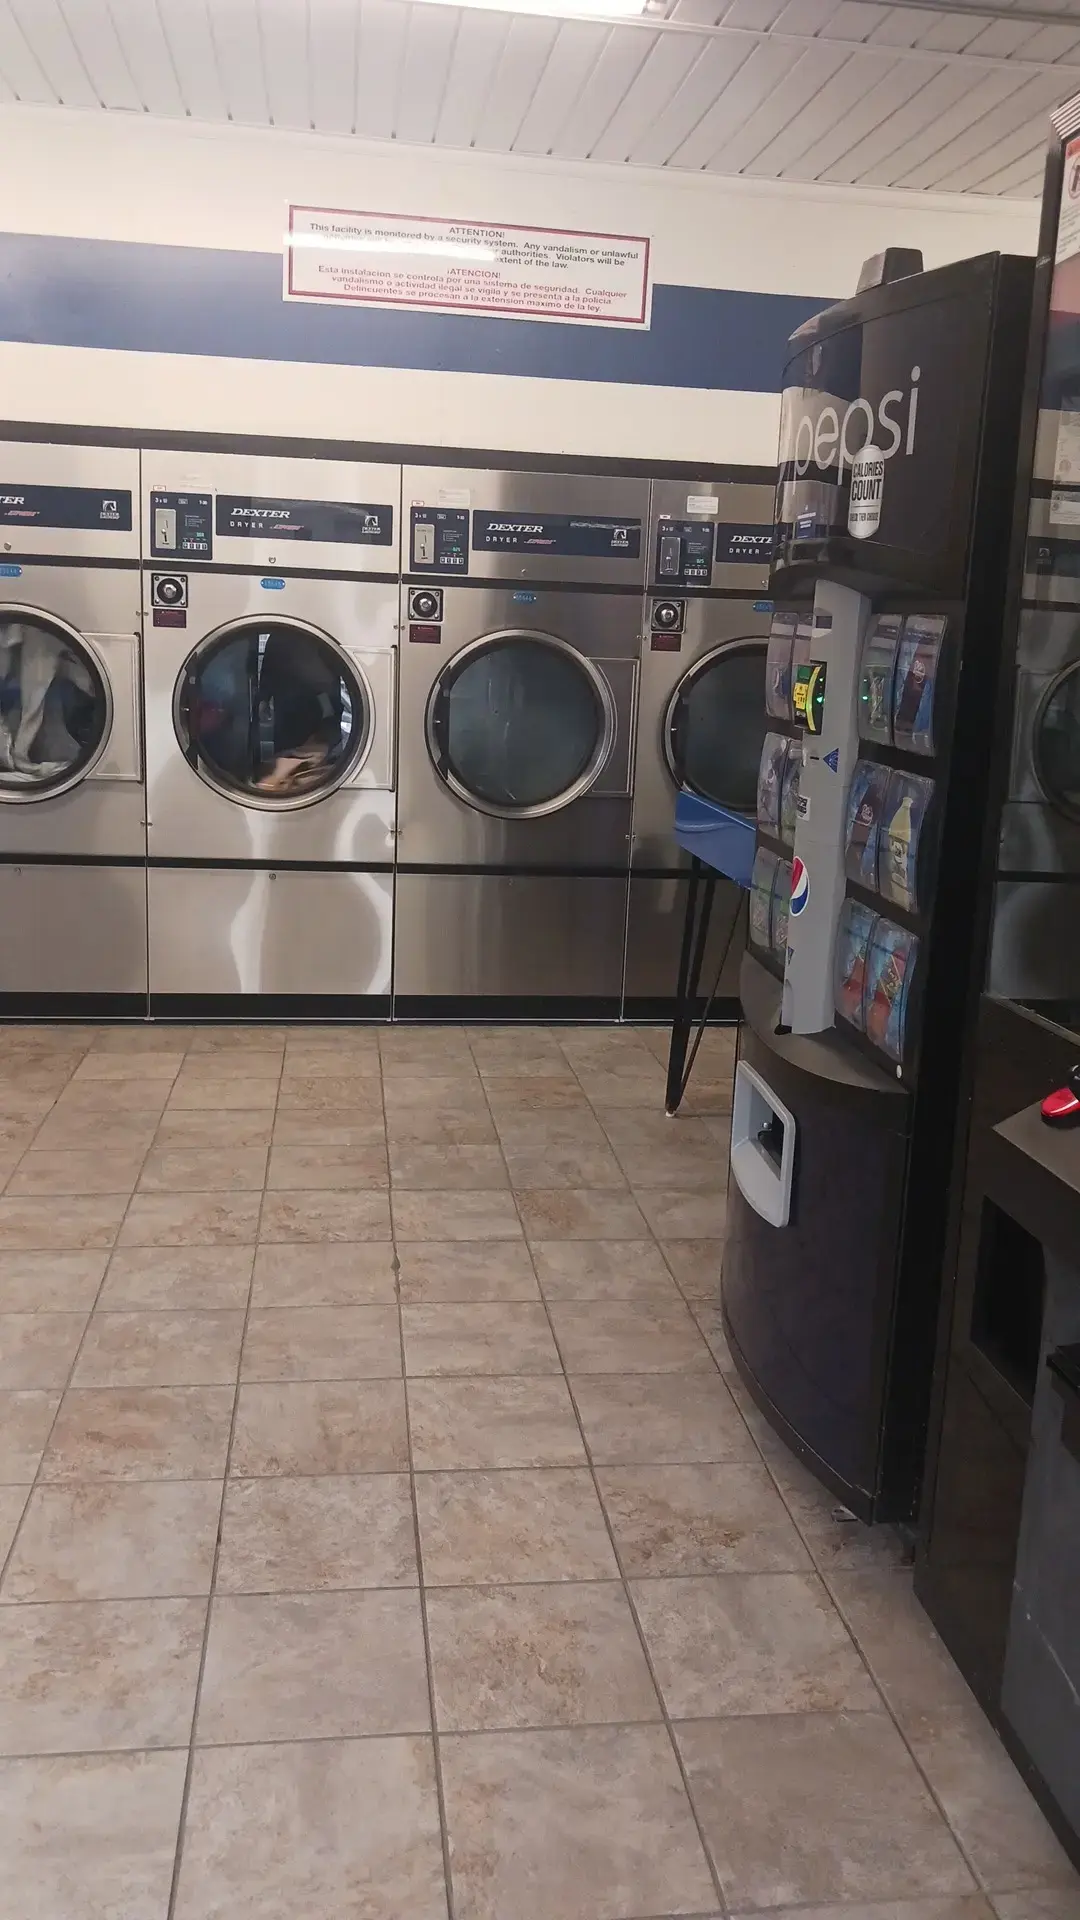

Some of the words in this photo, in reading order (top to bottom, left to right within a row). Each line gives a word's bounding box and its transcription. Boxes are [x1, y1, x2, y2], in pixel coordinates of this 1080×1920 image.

[449, 227, 505, 238] ATTENTION!
[310, 223, 329, 232] This
[331, 225, 362, 235] facility
[375, 229, 422, 239] monitored
[424, 233, 435, 241] by
[446, 236, 482, 246] security
[484, 239, 518, 248] system.
[524, 242, 540, 251] Any
[543, 245, 588, 254] vandalism
[601, 249, 639, 259] unlawful
[501, 249, 551, 259] authorities.
[556, 253, 595, 263] Violators
[597, 257, 612, 265] will
[524, 258, 533, 266] of
[535, 259, 550, 267] the
[552, 261, 569, 269] law.
[318, 265, 339, 273] Esta
[341, 267, 391, 278] instalacion
[406, 273, 444, 282] controla
[446, 276, 462, 284] por
[483, 279, 518, 289] sistema
[534, 284, 580, 294] seguridad.
[585, 288, 628, 298] Cualquier
[332, 275, 384, 286] vandalismo
[395, 280, 436, 290] actividad
[438, 282, 463, 292] ilegal
[477, 286, 501, 296] vigila
[524, 292, 562, 301] presenta
[572, 294, 580, 302] la
[344, 283, 403, 295] Delincuentes
[418, 291, 460, 300] procesan
[481, 296, 525, 306] extension
[527, 300, 562, 309] maximo
[587, 304, 602, 313] ley.
[793, 366, 921, 495] pepsi
[853, 461, 884, 478] CALORIES
[851, 479, 882, 501] COUNT
[230, 507, 291, 519] DEXTER
[229, 520, 264, 529] DRYER
[486, 523, 544, 533] DEXTER
[485, 535, 518, 543] DRYER
